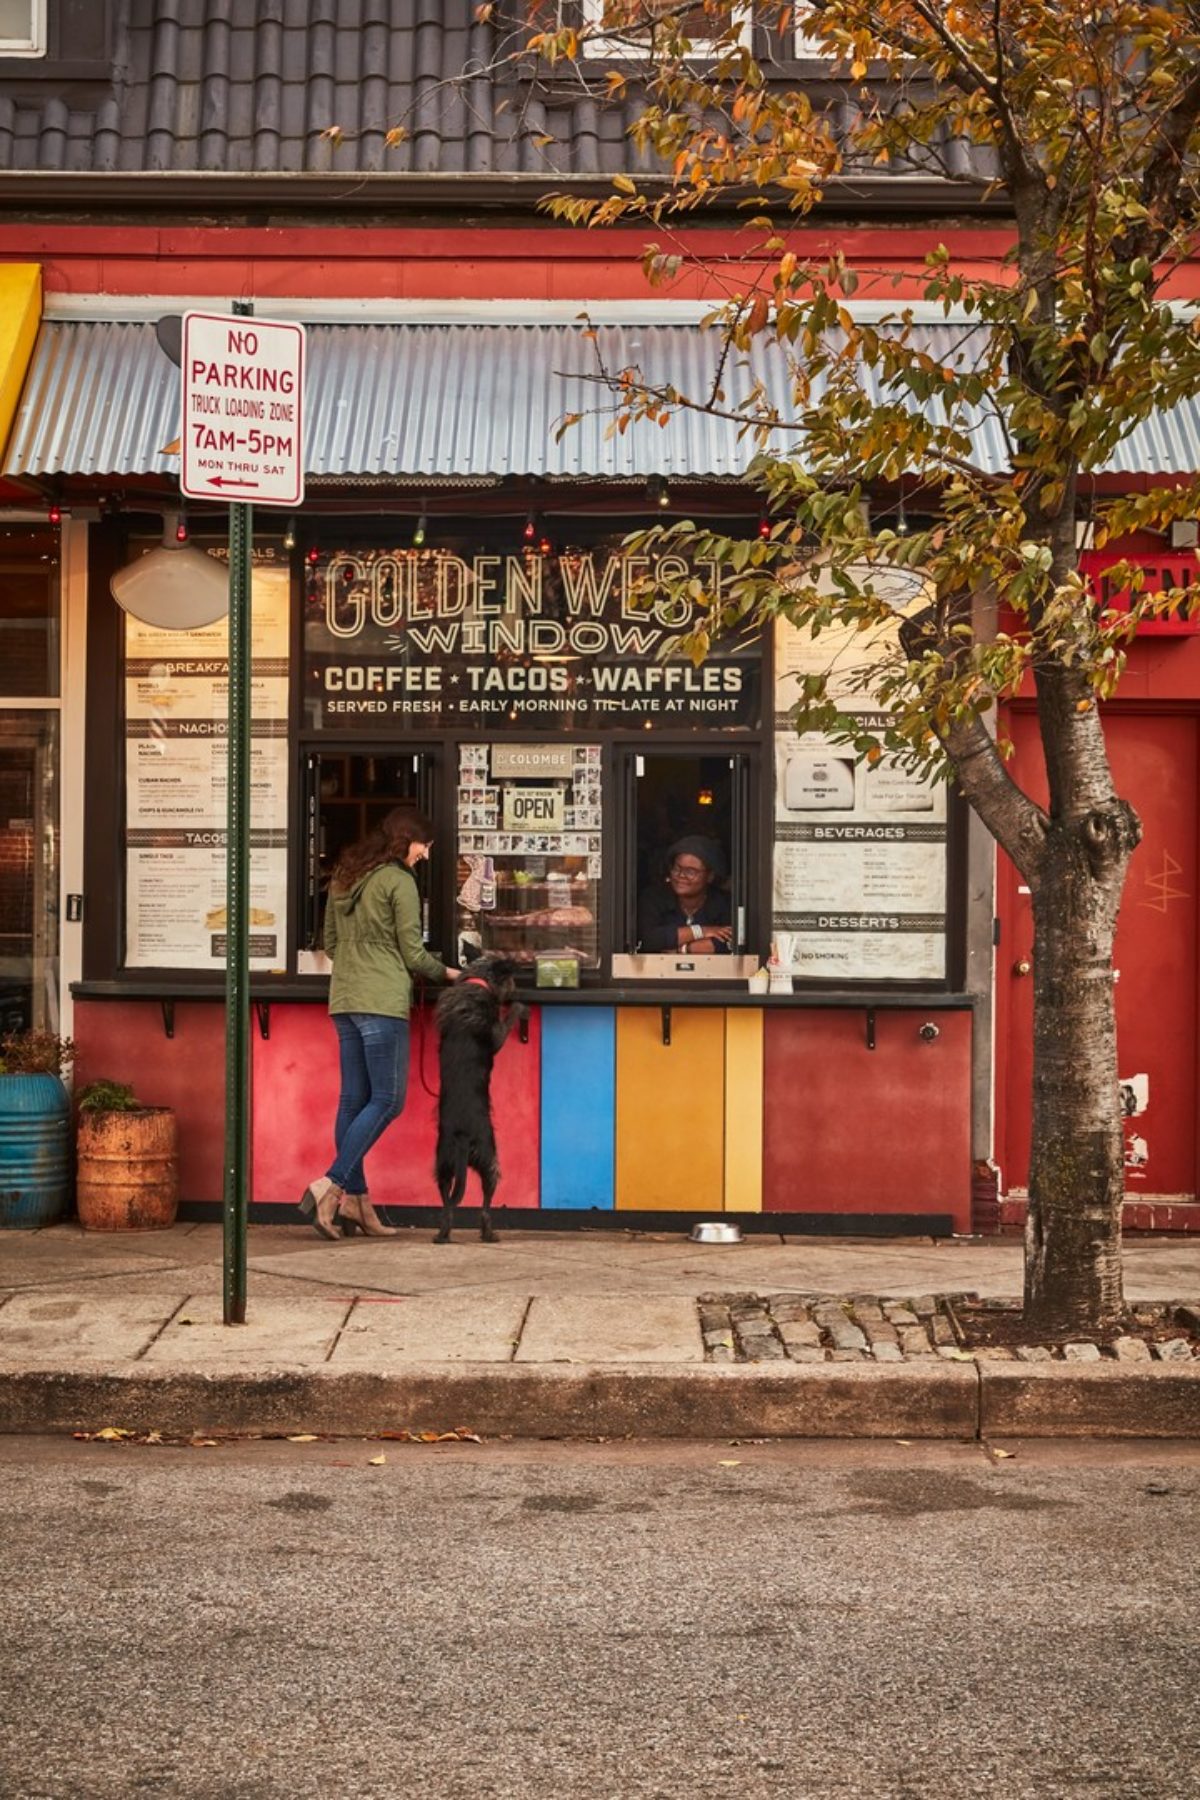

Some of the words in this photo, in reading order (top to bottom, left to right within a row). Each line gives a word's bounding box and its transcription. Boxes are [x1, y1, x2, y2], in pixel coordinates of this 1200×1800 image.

[228, 330, 258, 356] NO
[192, 360, 294, 394] PARKING
[192, 394, 220, 414] TRUCK
[225, 398, 264, 420] LOADING
[270, 402, 294, 422] ZONE
[192, 423, 293, 457] 7AM-5PM
[198, 459, 223, 470] MON
[227, 462, 258, 473] THRU
[263, 465, 286, 475] SAT
[326, 556, 543, 638] GOLDEN
[407, 621, 662, 654] WINDOW
[166, 662, 229, 673] BREAKFA
[324, 667, 442, 691] COFFEE
[466, 667, 569, 691] TACOS
[592, 667, 742, 692] WAFFLES
[327, 700, 387, 713] SERVED
[392, 700, 442, 713] FRESH
[459, 699, 507, 712] EARLY
[513, 699, 588, 712] MORNING
[621, 699, 660, 711] LATE
[665, 699, 685, 711] AT
[690, 699, 739, 711] NIGHT
[510, 754, 566, 765] COLOMBE
[514, 798, 554, 819] OPEN
[814, 827, 905, 839] BEVERAGES
[818, 916, 899, 929] DESSERTS
